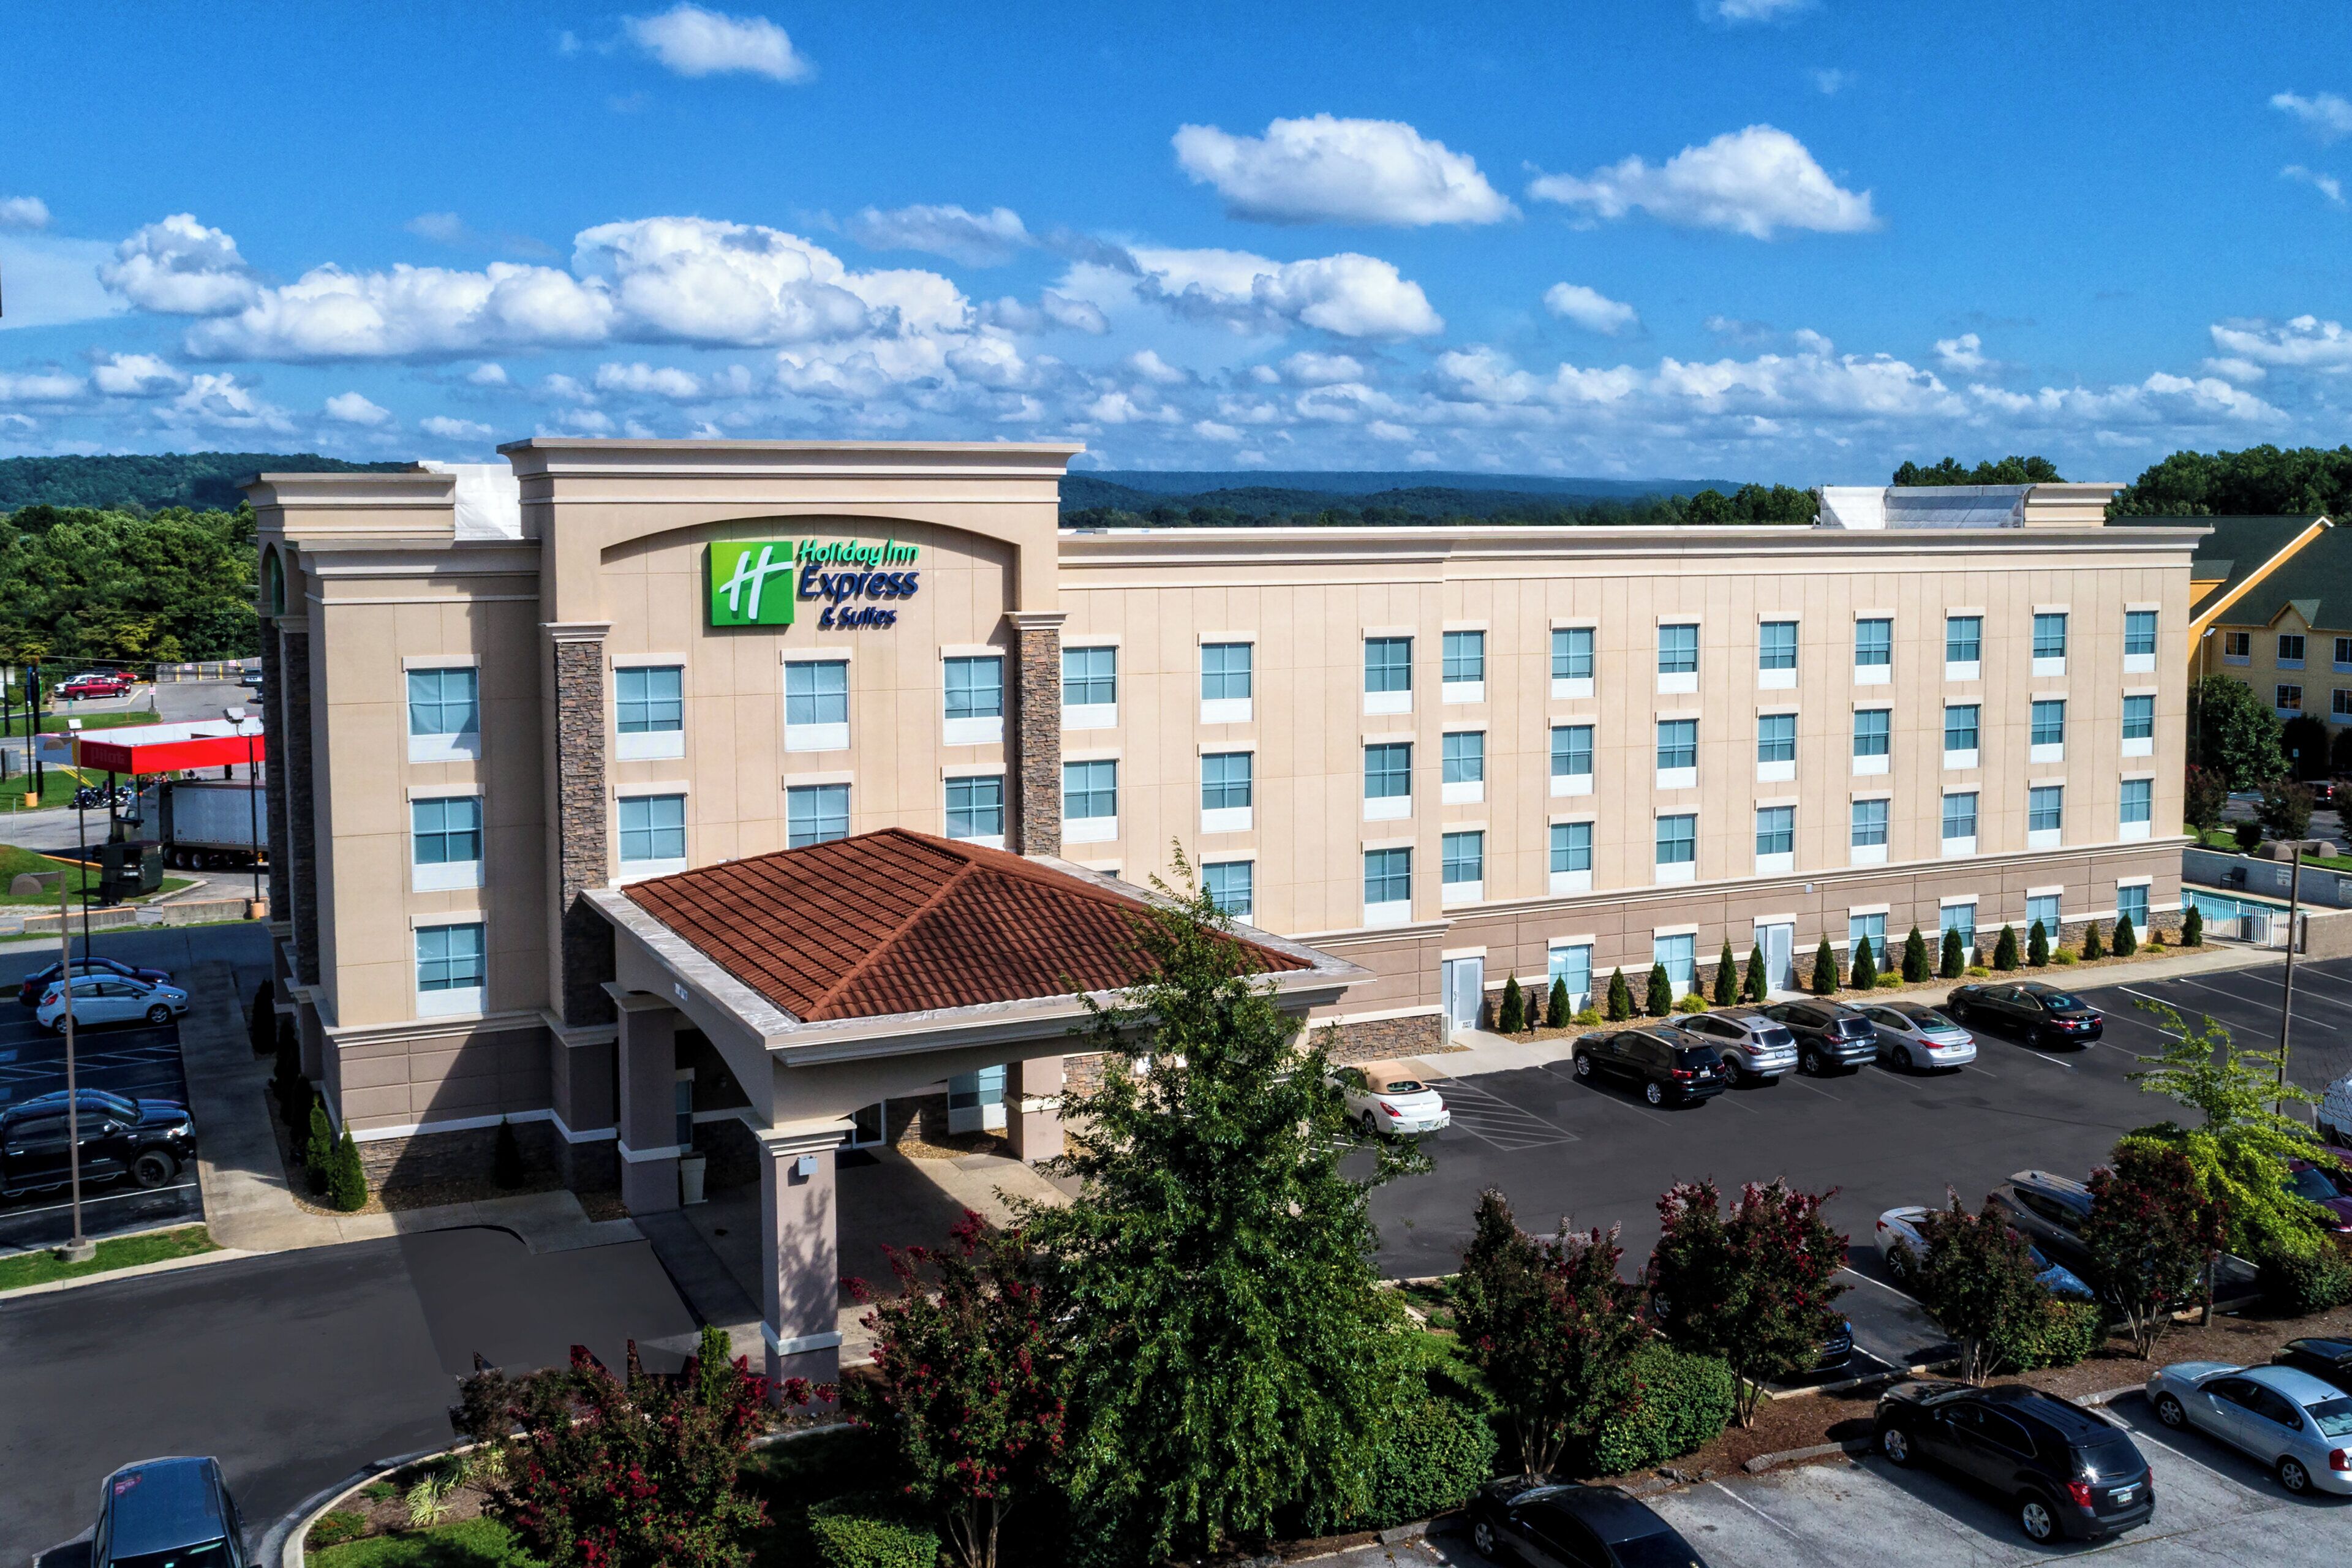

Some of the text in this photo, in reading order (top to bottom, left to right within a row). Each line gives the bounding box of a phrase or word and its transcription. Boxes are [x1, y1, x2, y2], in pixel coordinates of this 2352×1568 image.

[799, 538, 920, 567] Holiday Inn
[799, 564, 920, 604] Express
[821, 606, 898, 626] & Suites
[90, 747, 125, 765] Pilot
